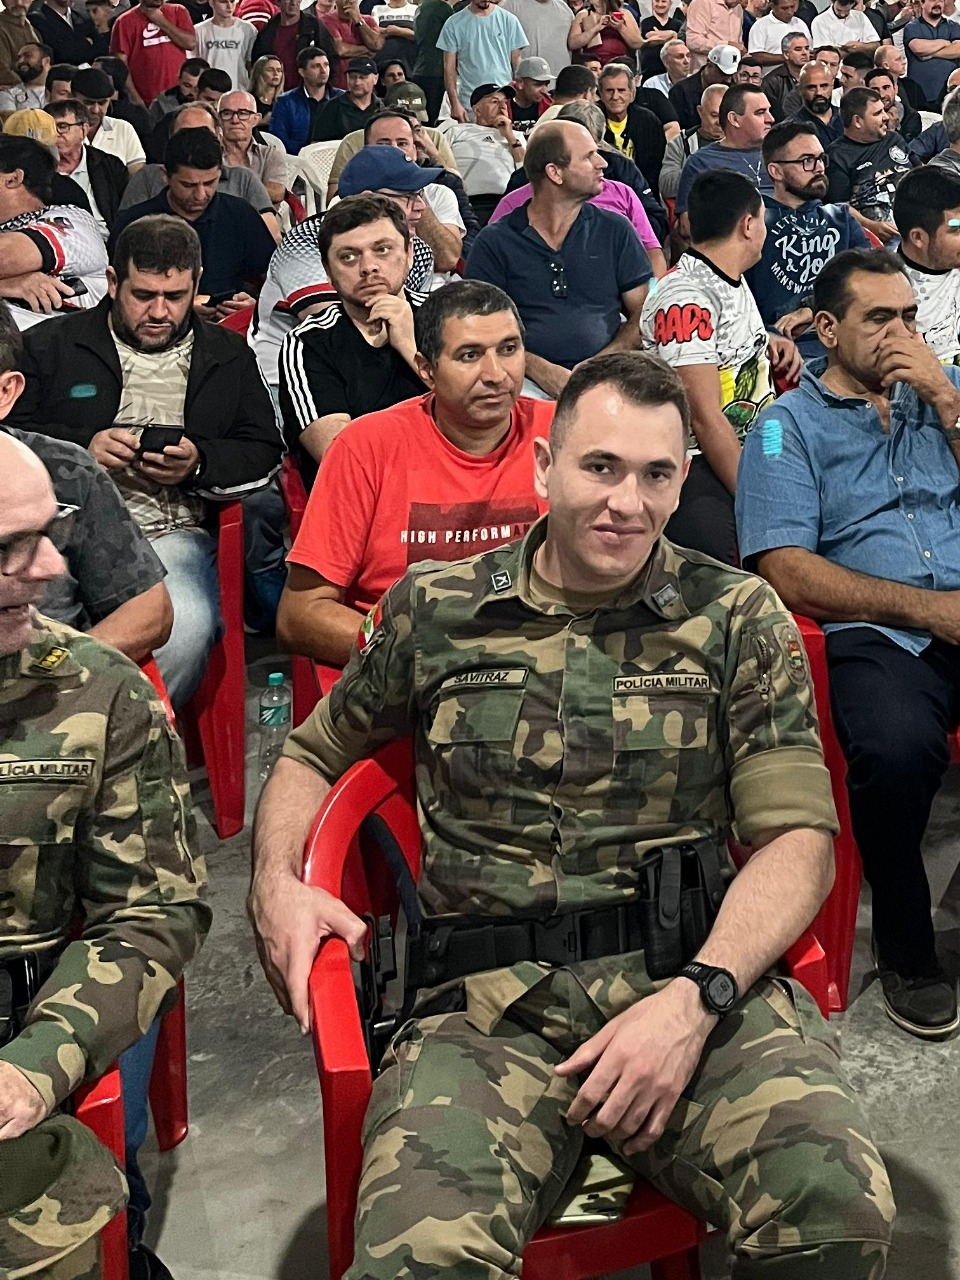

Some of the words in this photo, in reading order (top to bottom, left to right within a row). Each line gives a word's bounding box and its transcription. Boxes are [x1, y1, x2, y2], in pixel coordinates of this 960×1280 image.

[774, 227, 841, 260] King
[770, 261, 814, 294] MENSW
[785, 258, 798, 272] &
[799, 254, 829, 283] Jo
[400, 530, 437, 544] HIGH
[616, 676, 663, 690] POLÍCIA
[665, 676, 708, 688] MILITAR
[39, 763, 90, 776] MILITAR
